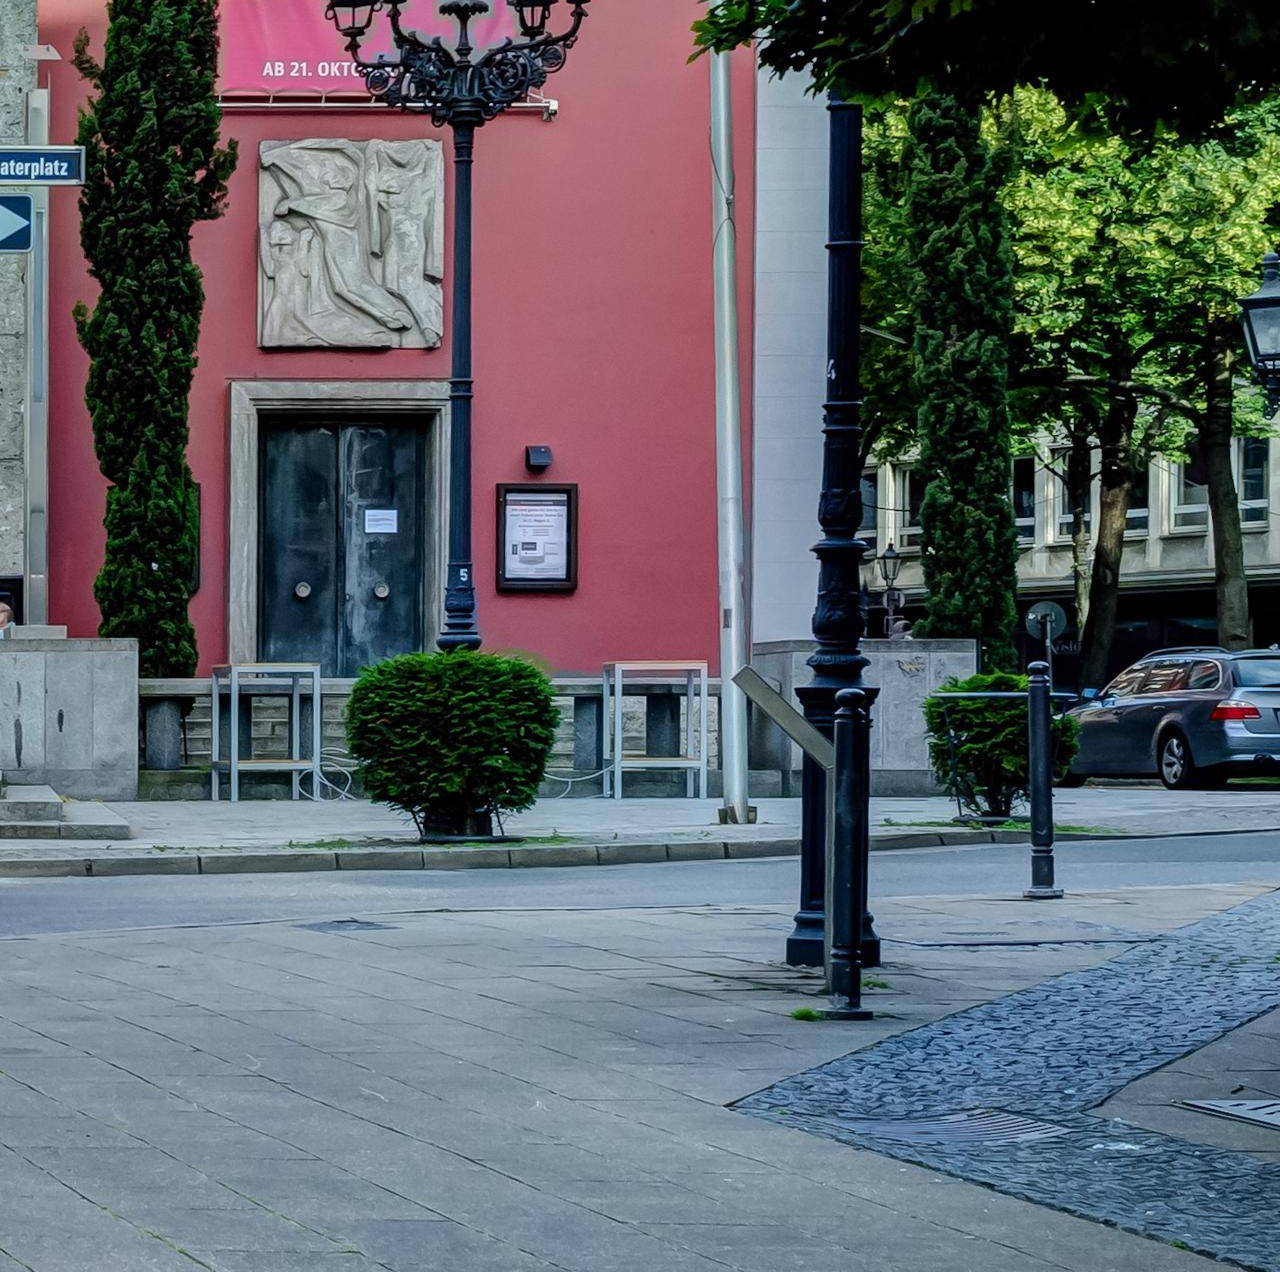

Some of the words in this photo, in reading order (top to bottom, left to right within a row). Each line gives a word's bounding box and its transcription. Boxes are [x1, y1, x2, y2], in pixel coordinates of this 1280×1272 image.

[263, 62, 285, 77] AB
[290, 62, 313, 77] 21.
[459, 568, 468, 582] 5
